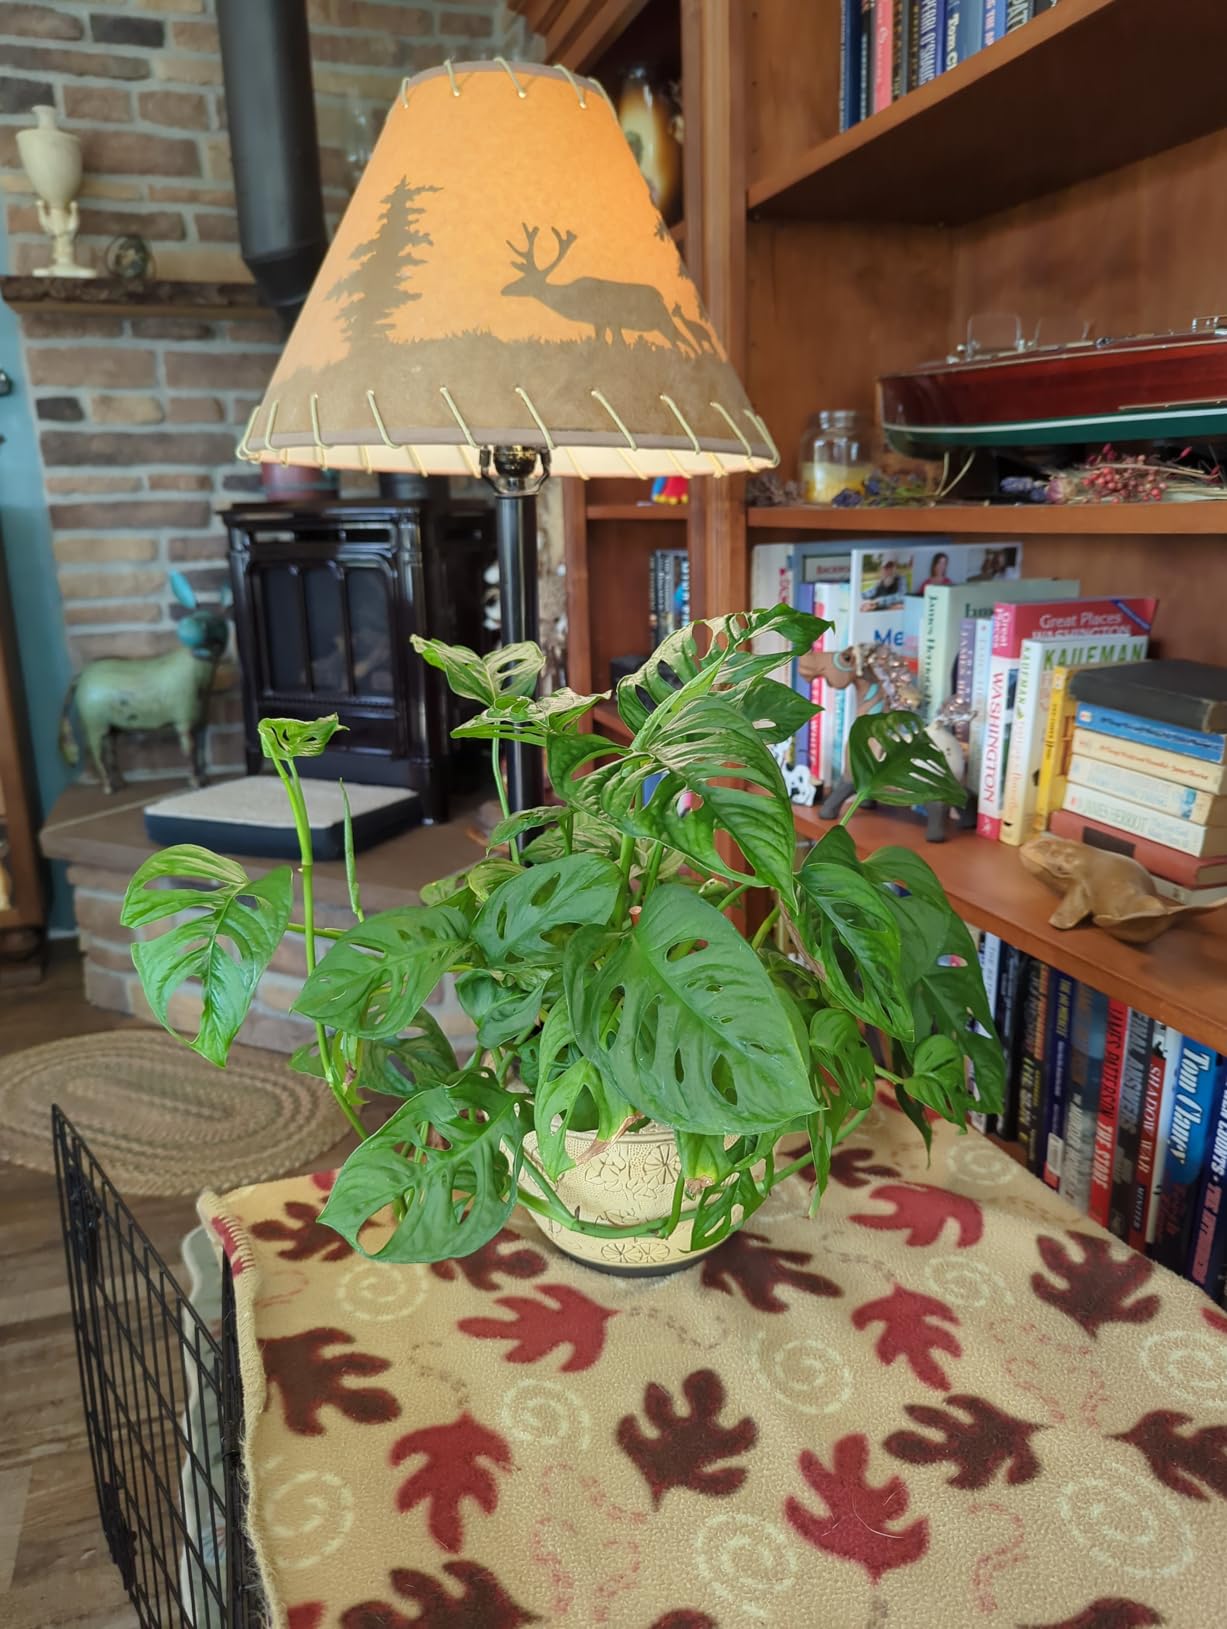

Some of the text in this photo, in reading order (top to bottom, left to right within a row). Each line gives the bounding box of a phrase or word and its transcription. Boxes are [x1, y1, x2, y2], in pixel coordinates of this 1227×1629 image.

[946, 12, 960, 53] Tom
[1039, 613, 1078, 630] Great
[1080, 611, 1123, 628] Places
[983, 672, 1004, 803] WASHINGTON
[1105, 1008, 1124, 1049] JAMES
[1129, 1010, 1150, 1055] FINAL
[1100, 1051, 1120, 1120] PATTERSON
[1119, 1052, 1146, 1135] ANSWERS
[1178, 1047, 1211, 1095] Tom
[1096, 1119, 1113, 1149] THE
[1136, 1063, 1162, 1175] SHADOW WAR
[1168, 1093, 1203, 1166] Clancy
[1210, 1114, 1227, 1178] COONTS
